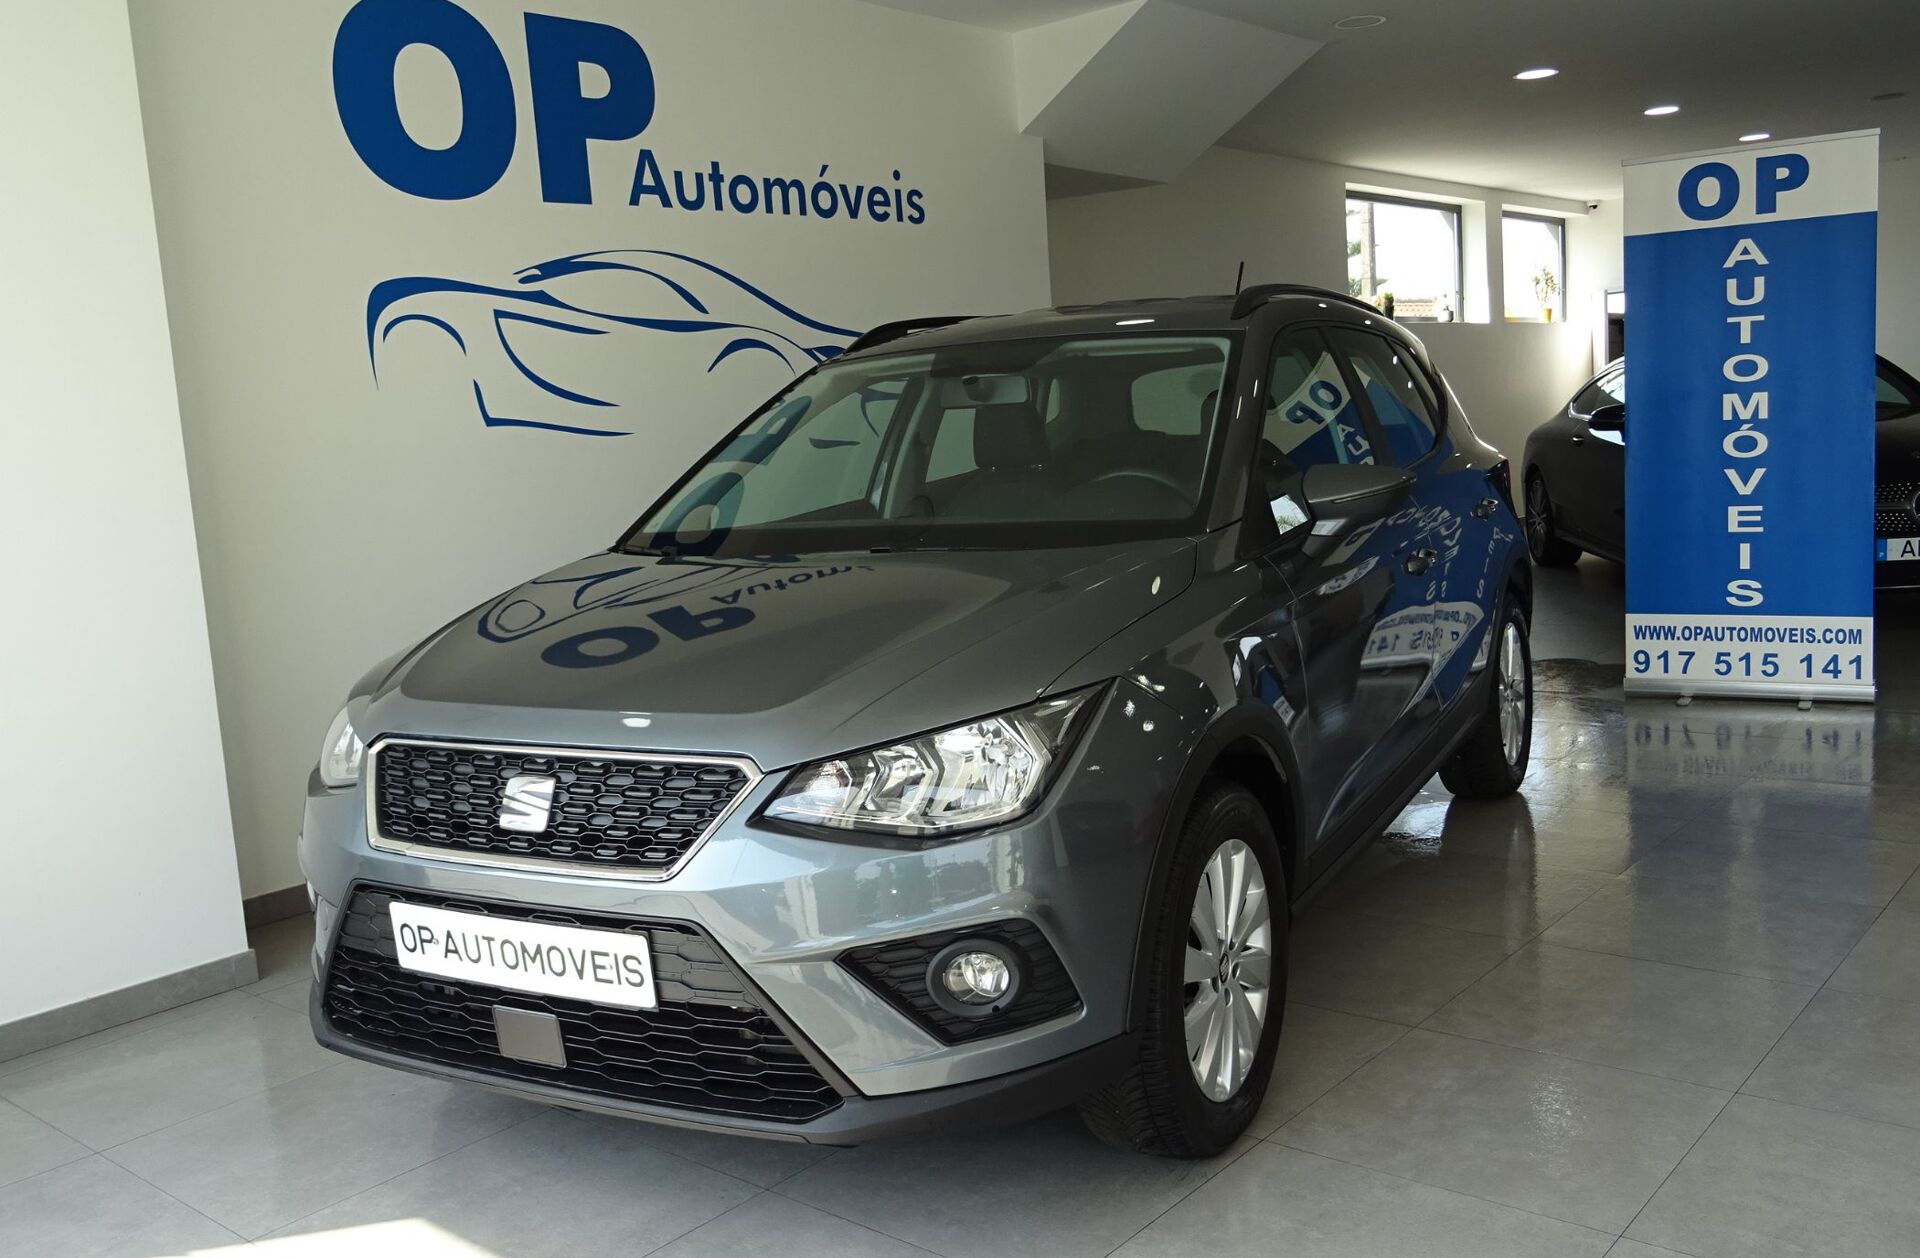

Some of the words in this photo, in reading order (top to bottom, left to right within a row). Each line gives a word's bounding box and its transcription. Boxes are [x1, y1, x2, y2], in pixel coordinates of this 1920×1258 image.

[333, 0, 655, 204] OP
[629, 149, 925, 225] Automóveis
[1677, 153, 1809, 221] OP
[1722, 238, 1769, 607] AUTOMÓVEIS
[1900, 539, 1920, 558] A
[1633, 625, 1862, 645] WWW.OPAUTOMOVEIS.COM
[1633, 650, 1695, 674] 917
[1714, 652, 1779, 677] 515
[1799, 653, 1862, 679] 141
[400, 923, 435, 954] OP
[445, 930, 645, 987] AUTOMOVEIS
